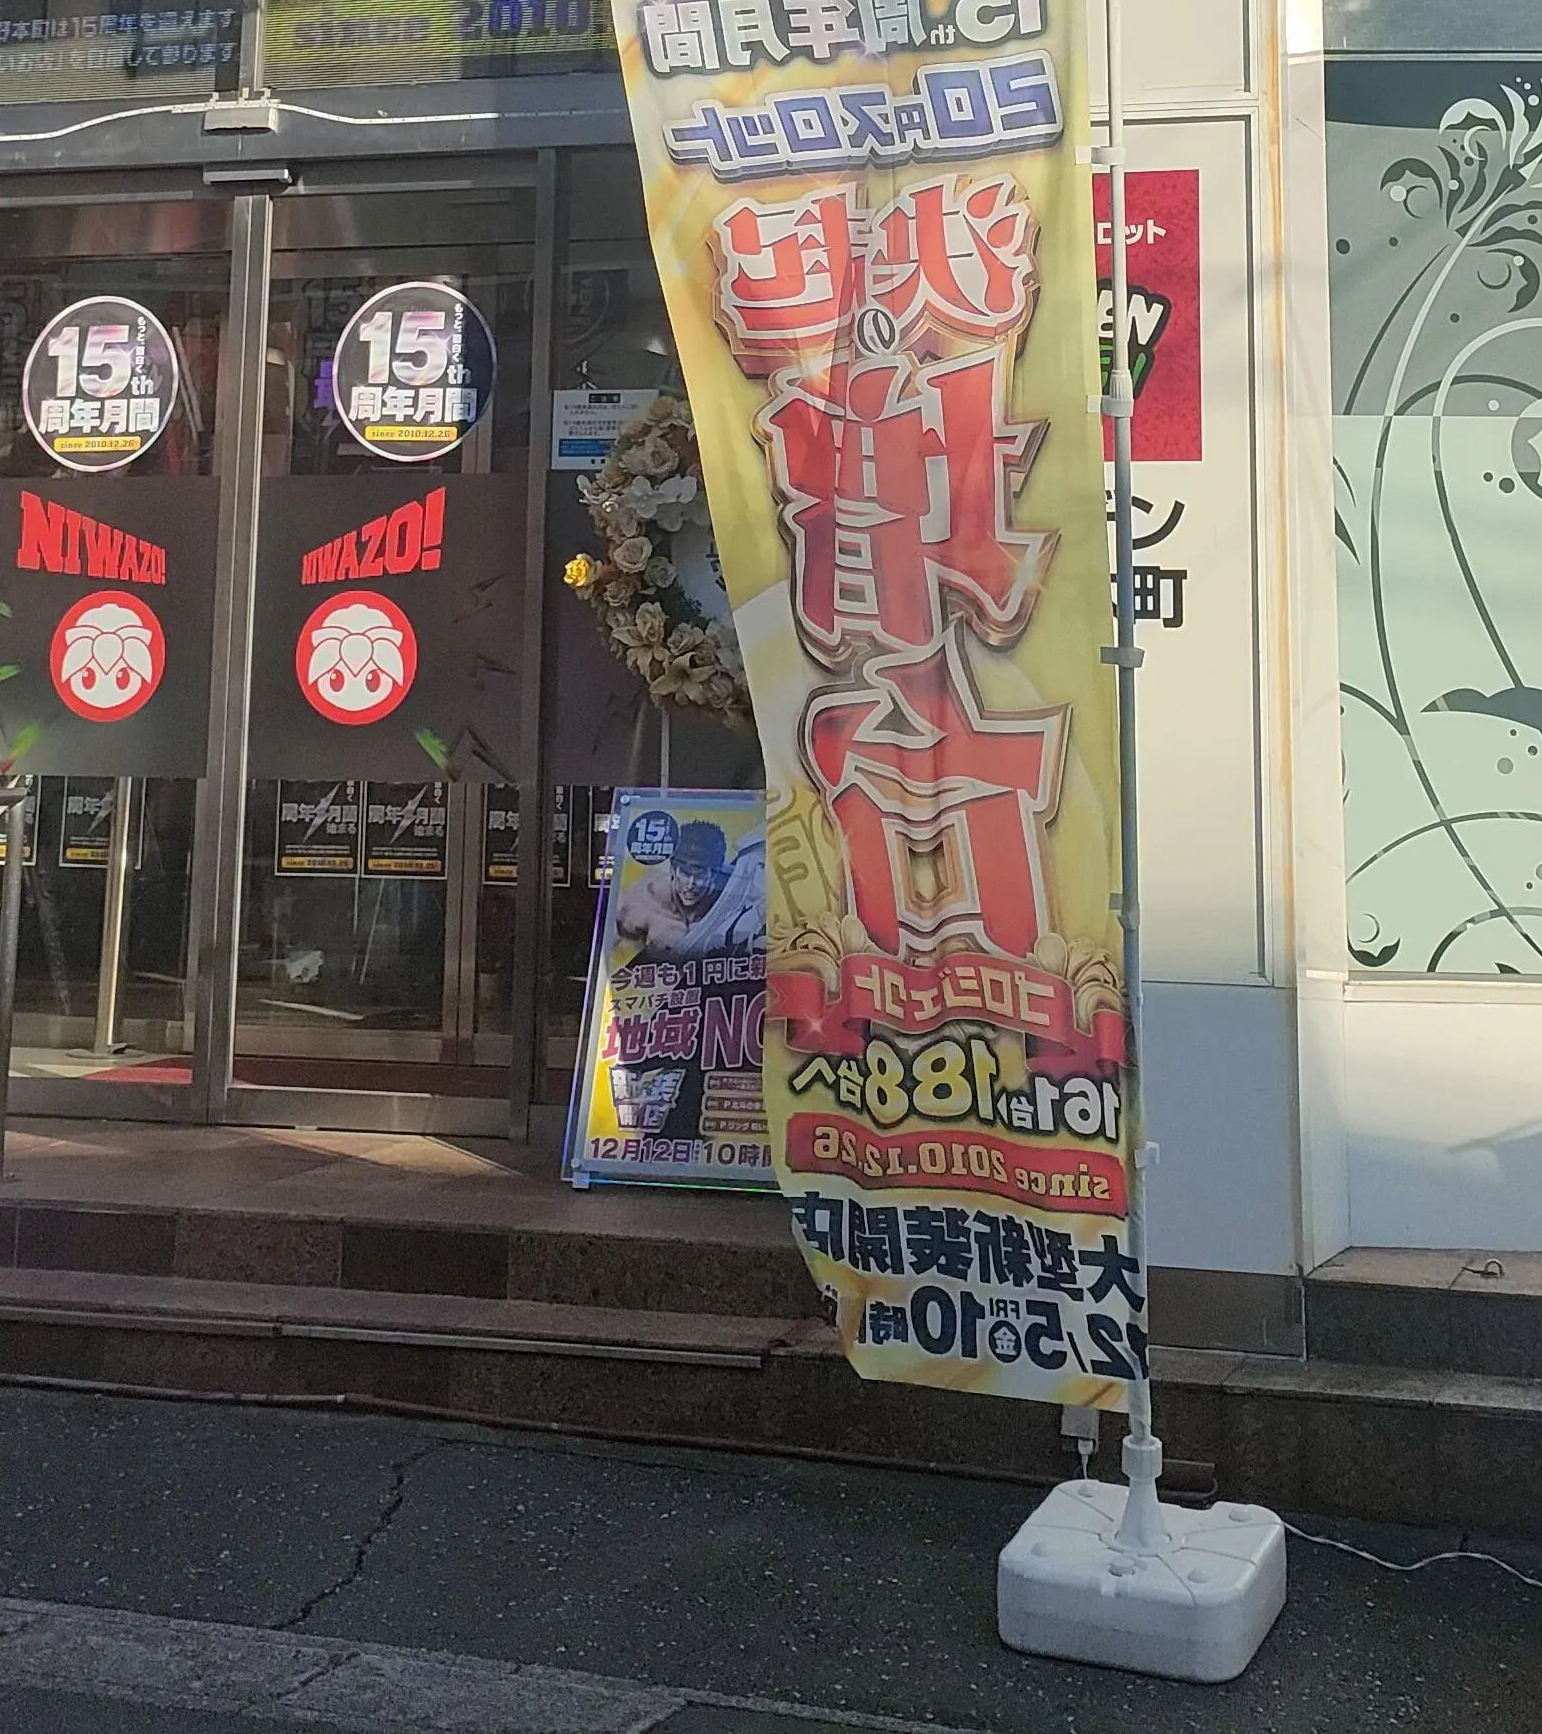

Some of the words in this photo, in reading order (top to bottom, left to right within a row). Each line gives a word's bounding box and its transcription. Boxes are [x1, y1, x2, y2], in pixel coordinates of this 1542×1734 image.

[48, 324, 133, 398] 15
[130, 375, 155, 396] th
[359, 311, 448, 386] 15
[447, 363, 473, 386] th
[37, 397, 161, 434] 周年月間
[348, 386, 478, 423] 周年月間
[17, 489, 167, 586] NIWAZO!
[301, 486, 447, 586] NIWAZO!
[636, 818, 665, 843] 15
[602, 1007, 702, 1066] 地域
[590, 1137, 691, 1164] 12月12日
